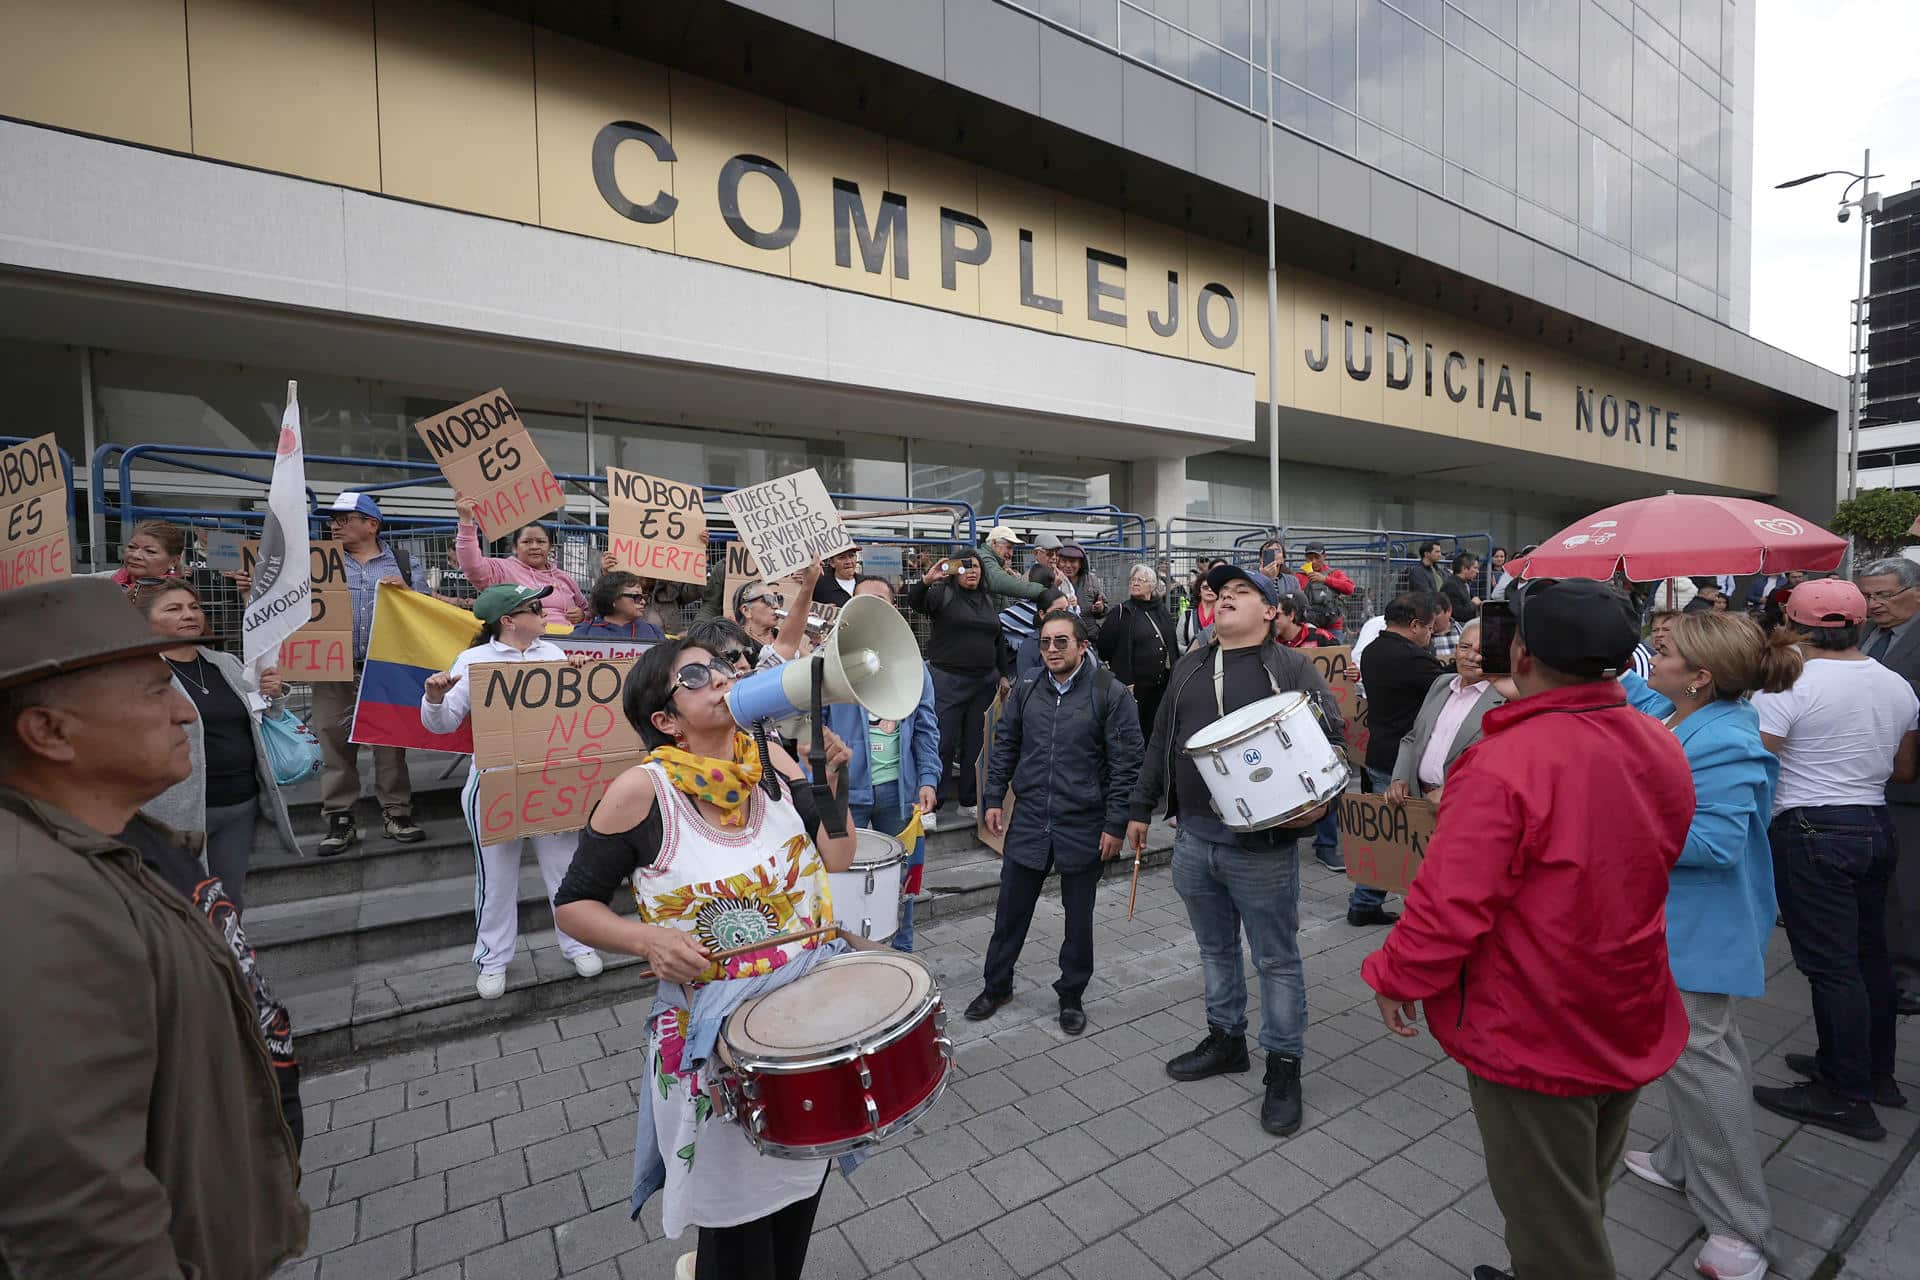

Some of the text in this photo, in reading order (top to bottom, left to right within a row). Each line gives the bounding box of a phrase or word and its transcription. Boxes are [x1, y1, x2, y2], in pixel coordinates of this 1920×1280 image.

[591, 120, 1681, 452] COMPLEJO JUDICIAL NORTE
[426, 395, 517, 458] NOBOA
[478, 437, 521, 482] ES
[471, 469, 564, 533] MAFIA
[614, 471, 704, 513] NOBOA
[787, 477, 798, 497] Y
[8, 497, 43, 541] ES
[640, 508, 685, 539] ES
[743, 497, 809, 533] FISCALES
[750, 511, 828, 554] SIRVIENTES
[613, 538, 705, 578] MUERTE
[759, 523, 851, 576] DE LOS NARCOS
[484, 664, 622, 710] NOBO
[547, 704, 615, 743] NO
[541, 743, 602, 785] ES
[1246, 751, 1259, 763] 04
[1338, 799, 1408, 845] NOBOA
